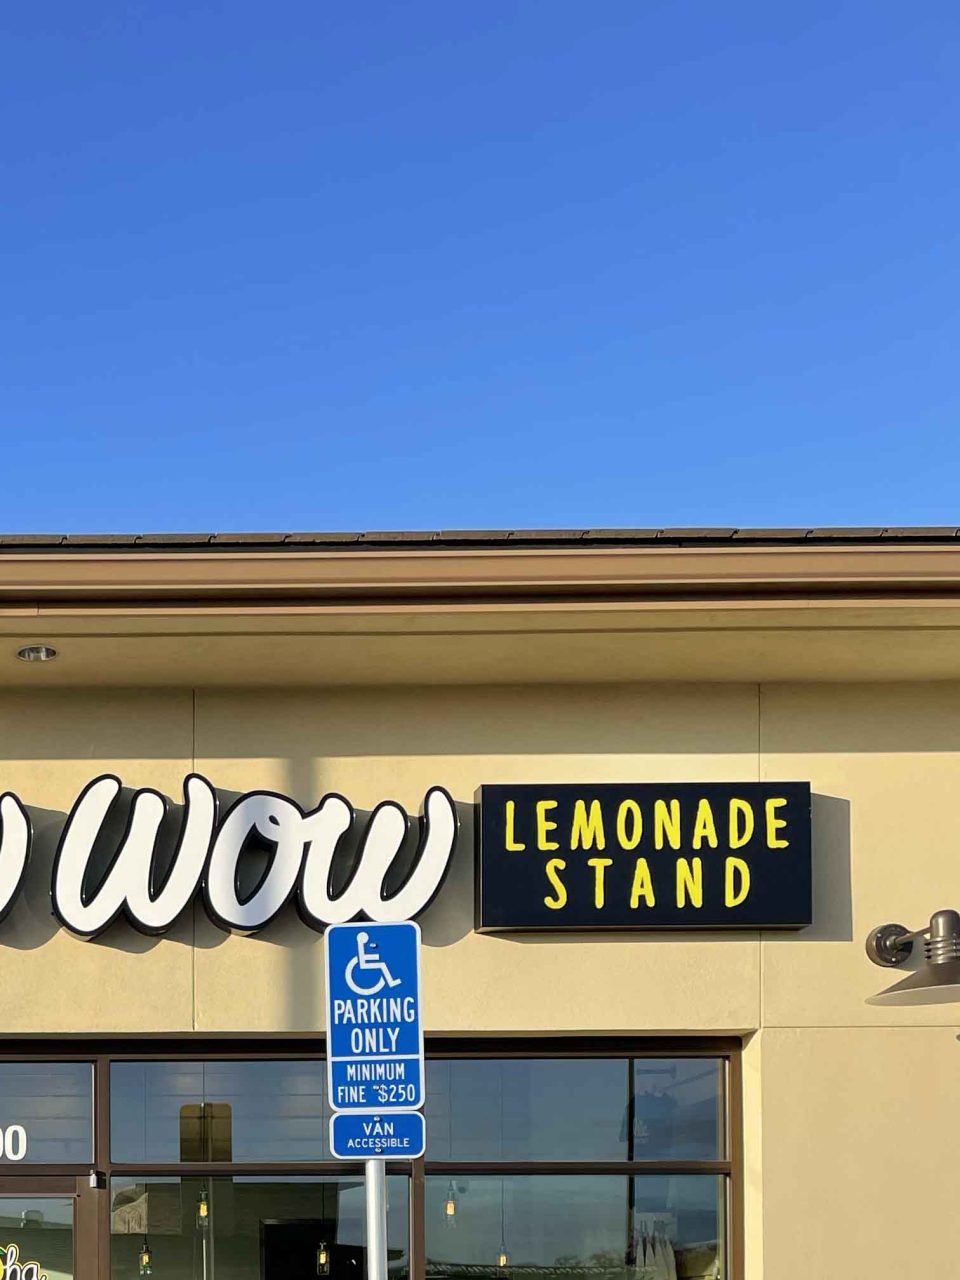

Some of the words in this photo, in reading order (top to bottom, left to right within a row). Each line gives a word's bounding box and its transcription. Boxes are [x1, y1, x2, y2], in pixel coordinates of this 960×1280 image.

[505, 798, 789, 851] LEMONADE
[544, 856, 751, 909] STAND
[334, 997, 415, 1024] PARKING
[350, 1027, 400, 1054] ONLY
[346, 1062, 405, 1081] MINIMUM
[338, 1085, 366, 1104] FINE
[377, 1083, 416, 1104] $250
[362, 1122, 394, 1136] VAN
[347, 1138, 410, 1149] ACCESSIBLE
